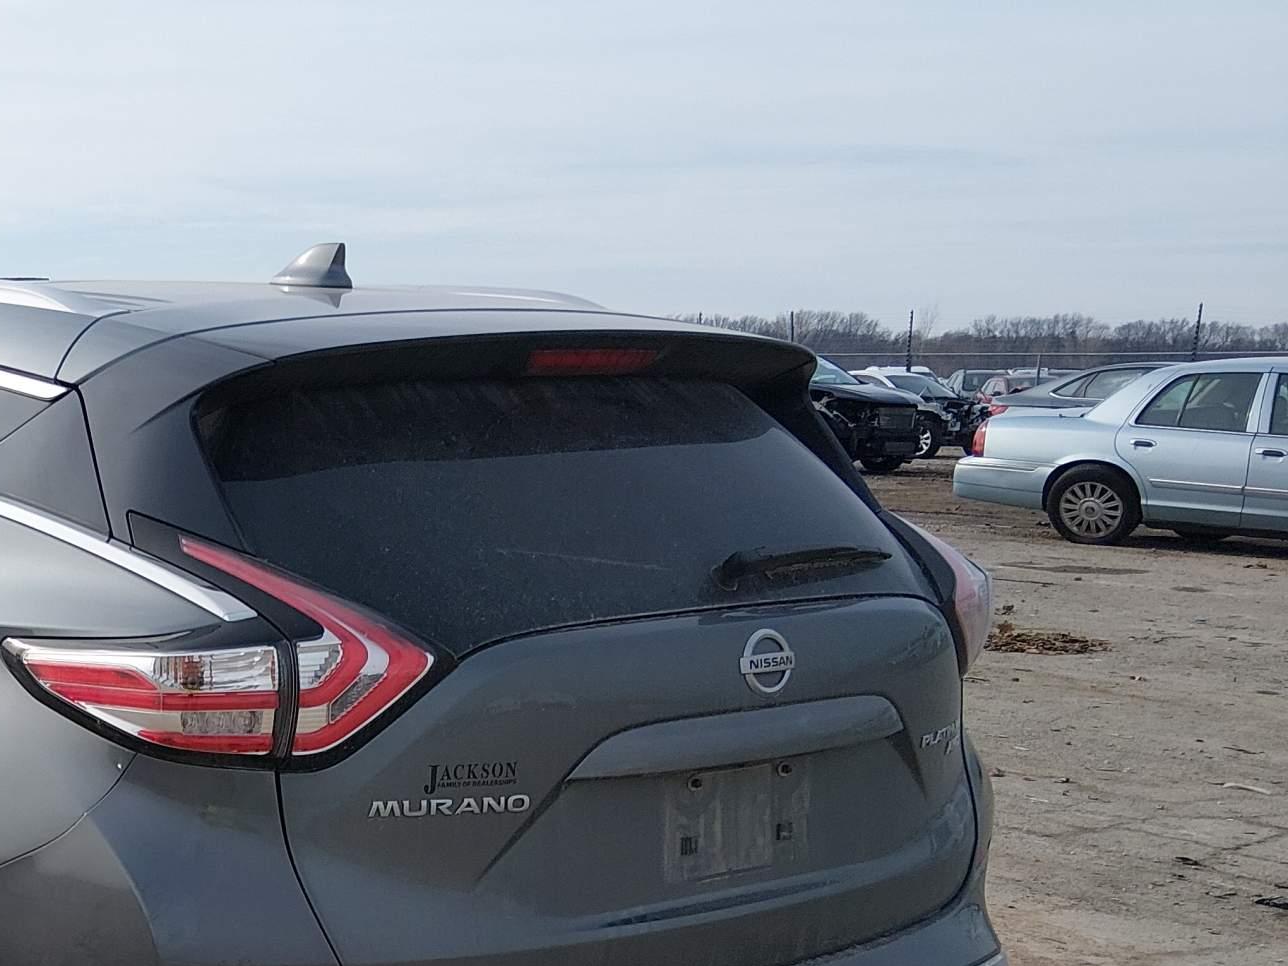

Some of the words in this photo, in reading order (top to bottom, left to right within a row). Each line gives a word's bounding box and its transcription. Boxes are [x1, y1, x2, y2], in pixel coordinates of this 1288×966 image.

[749, 656, 792, 669] NISSAN
[423, 762, 518, 795] JACKSON
[368, 794, 531, 818] MURANO
